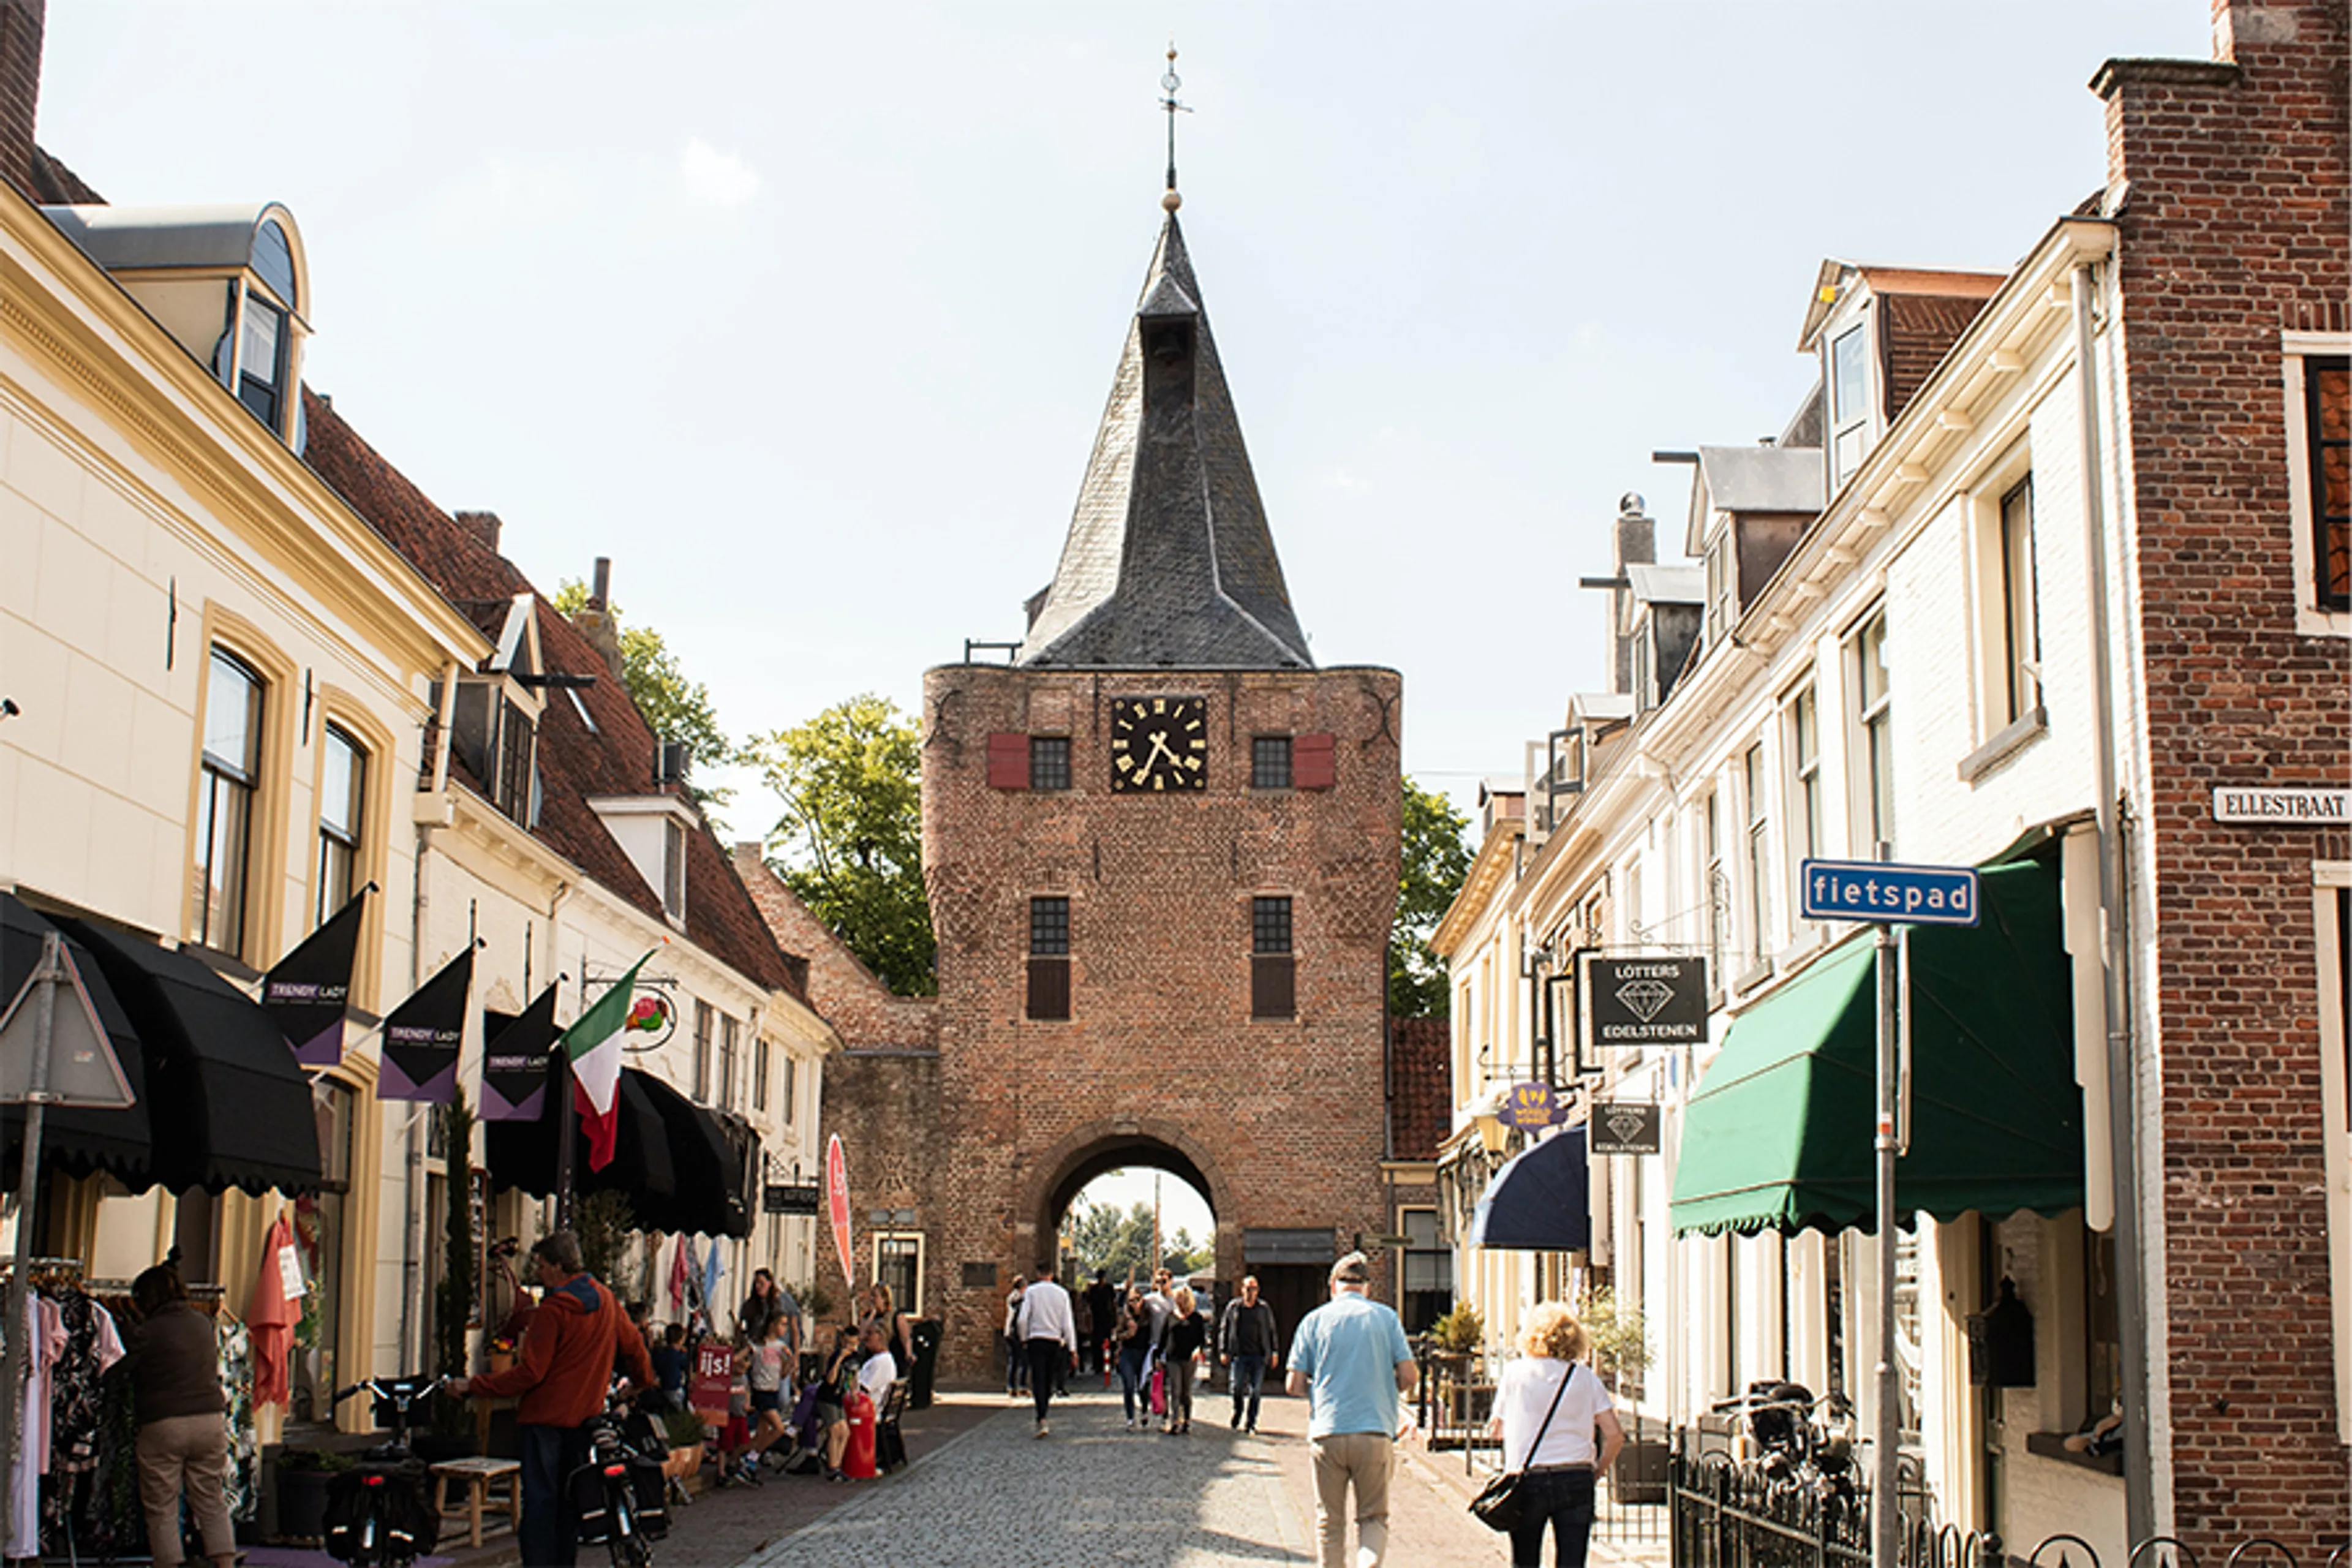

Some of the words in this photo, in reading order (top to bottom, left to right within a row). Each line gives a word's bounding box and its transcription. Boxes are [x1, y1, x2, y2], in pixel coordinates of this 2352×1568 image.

[2225, 794, 2345, 819] ELLESTRAAT
[1814, 875, 1967, 913] fietspad
[271, 982, 317, 997] TRENDY
[318, 986, 347, 997] LADY
[391, 1027, 434, 1041] TRENDY
[435, 1030, 461, 1041] LADY
[1602, 1023, 1698, 1039] EDELSTENEN
[489, 1055, 526, 1067] TRENDY
[1595, 1142, 1657, 1153] EDELSTENEN
[700, 1351, 731, 1378] ijs!
